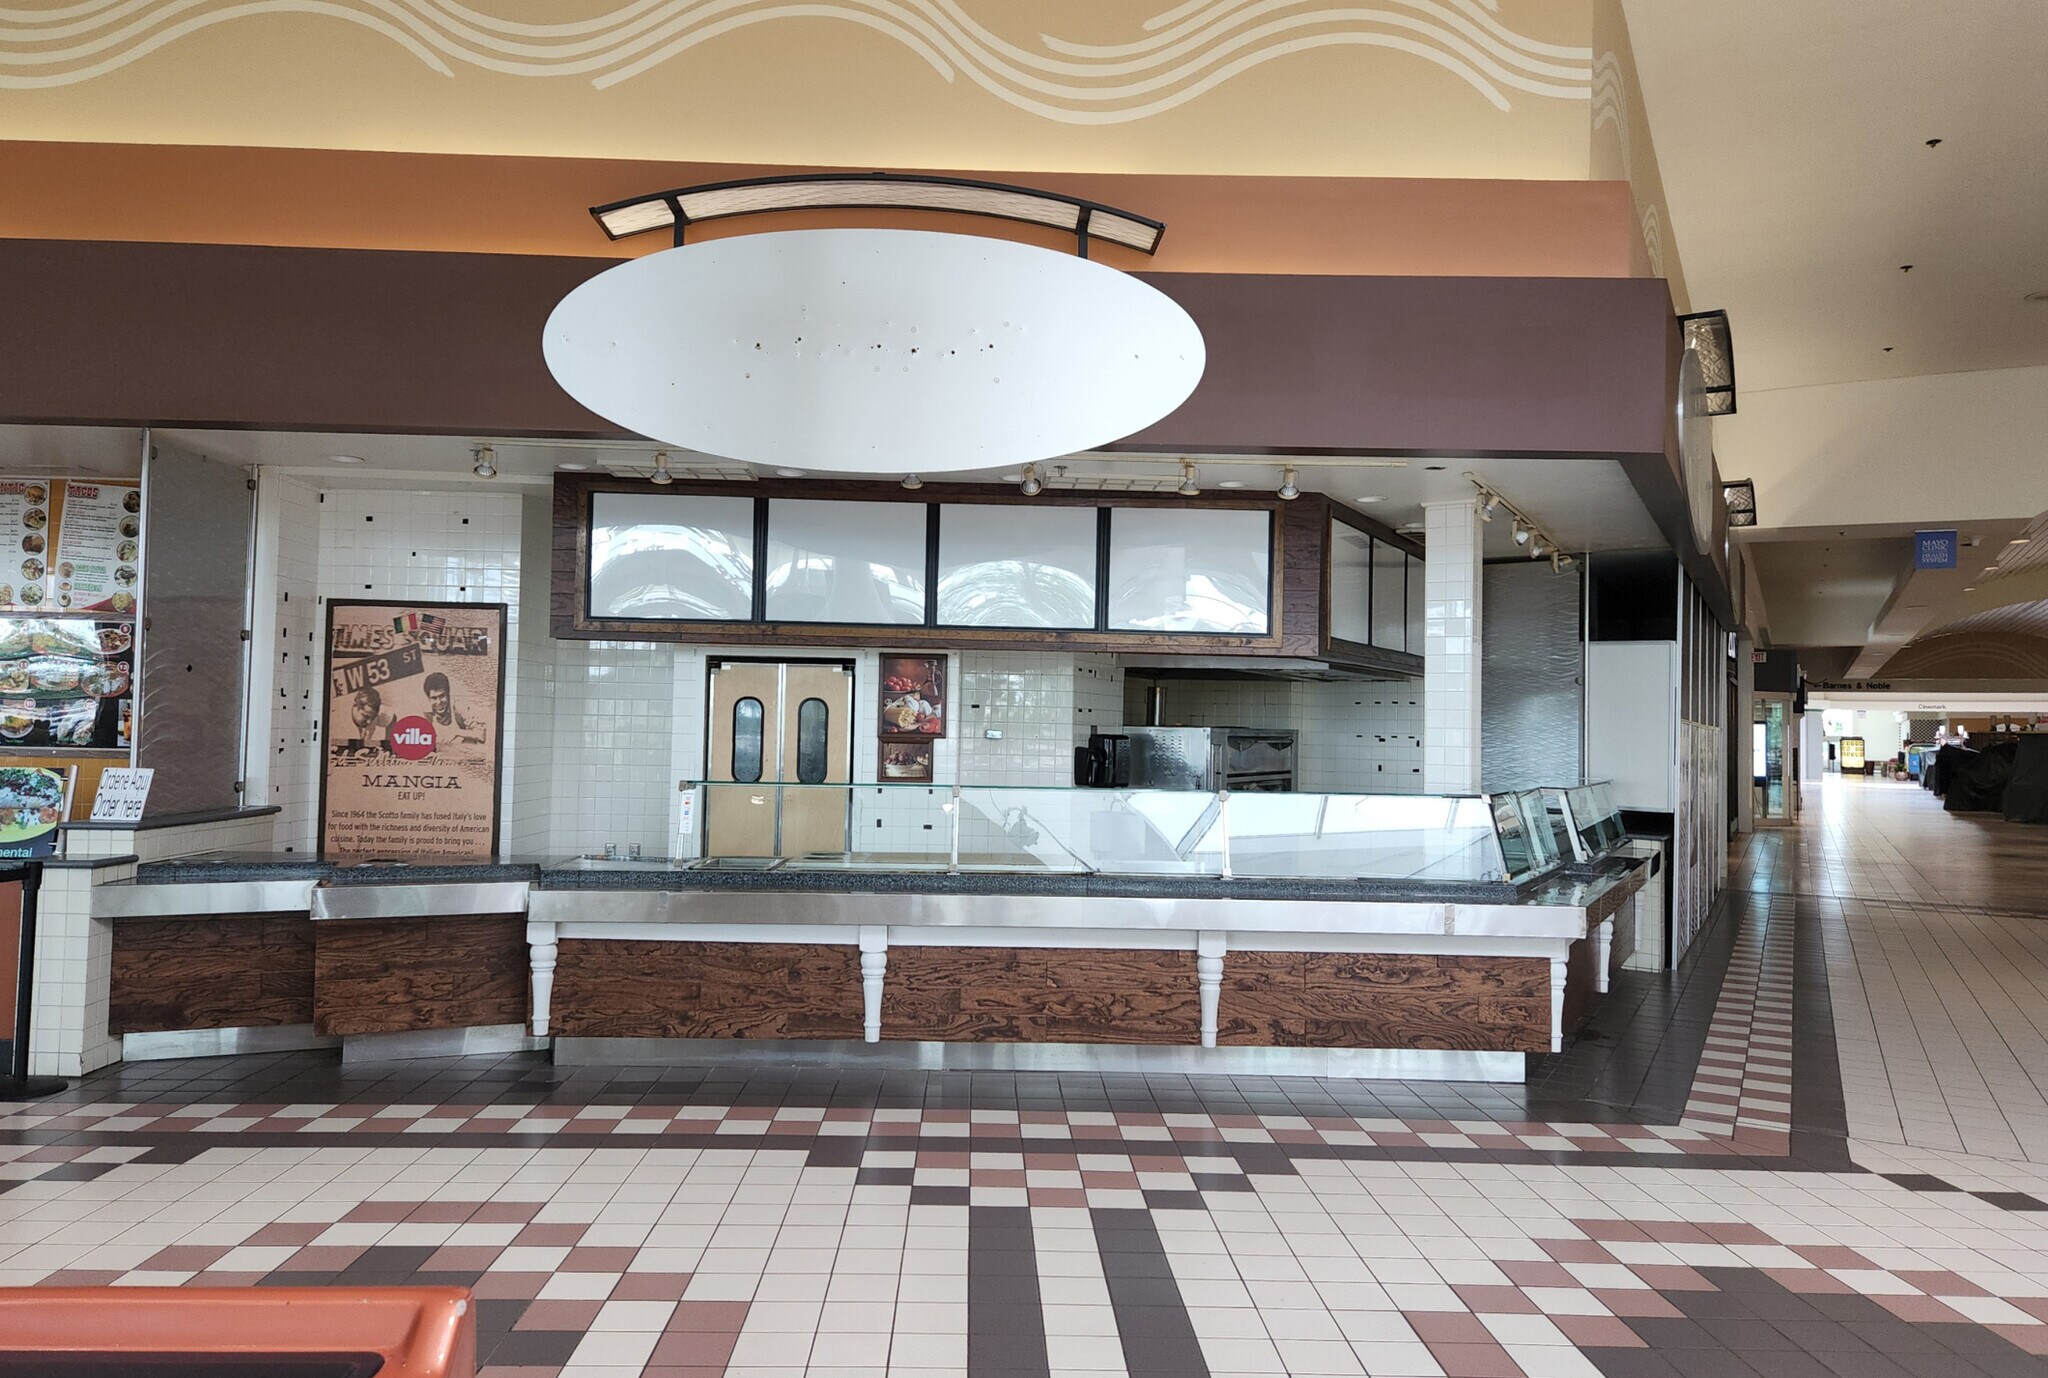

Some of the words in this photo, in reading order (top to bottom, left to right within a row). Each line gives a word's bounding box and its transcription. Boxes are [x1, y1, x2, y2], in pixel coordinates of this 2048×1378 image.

[68, 486, 98, 498] TACOS
[346, 665, 364, 690] W
[366, 658, 390, 684] 53
[402, 649, 417, 663] ST
[1822, 682, 1852, 690] Barnes
[1856, 682, 1862, 690] &
[1866, 682, 1891, 690] Noble
[393, 728, 432, 745] villa
[100, 768, 130, 790] Ordene
[362, 774, 462, 789] MANGIA
[397, 791, 411, 800] EAT
[412, 791, 425, 801] UP!
[92, 792, 120, 817] Order
[120, 794, 142, 818] here
[331, 810, 348, 818] Since
[378, 811, 399, 819] Scotto
[400, 811, 419, 820] family
[421, 812, 432, 820] has
[433, 812, 451, 820] fused
[452, 812, 472, 821] Italy's
[473, 813, 487, 821] love
[328, 822, 337, 830] for
[338, 823, 353, 831] food
[354, 823, 368, 831] with
[369, 823, 381, 831] the
[381, 823, 408, 831] richness
[409, 824, 421, 832] and
[422, 824, 450, 834] diversity
[459, 825, 489, 833] American
[330, 834, 355, 843] cuisine.
[356, 835, 375, 844] Today
[376, 835, 386, 843] the
[388, 836, 407, 845] family
[415, 837, 435, 845] proud
[444, 837, 461, 846] bring
